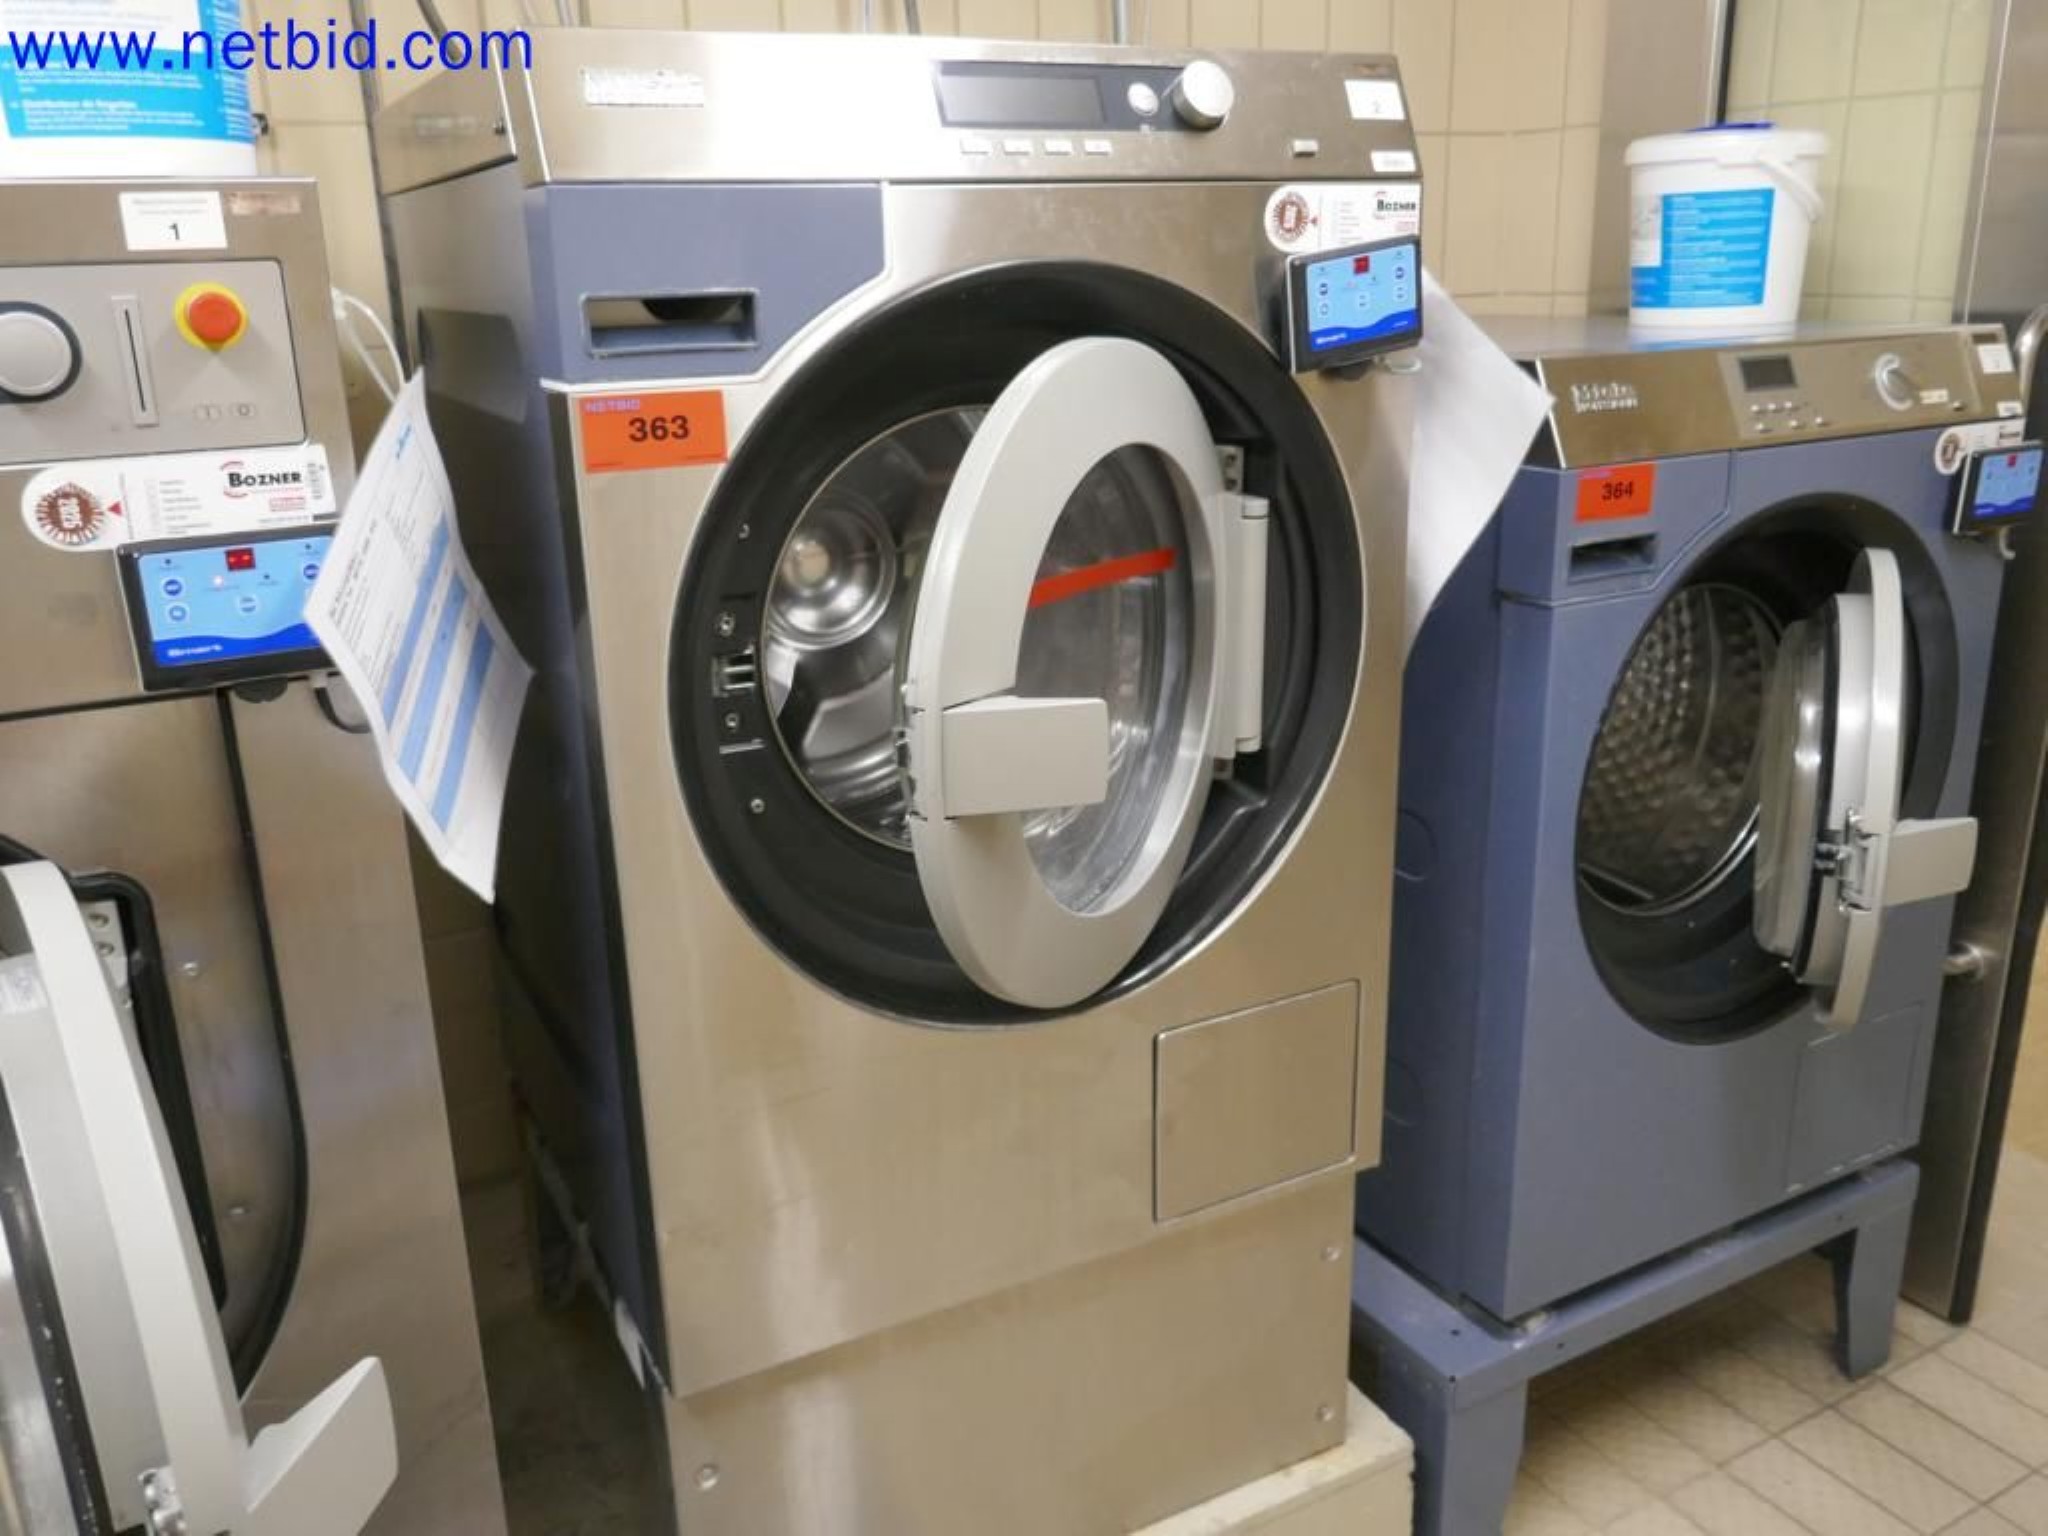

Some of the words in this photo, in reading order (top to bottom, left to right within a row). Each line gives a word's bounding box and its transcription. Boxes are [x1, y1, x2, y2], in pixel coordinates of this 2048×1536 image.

[168, 223, 180, 240] 1
[628, 414, 690, 443] 363
[228, 471, 302, 488] BOZNER
[1602, 481, 1634, 500] 364
